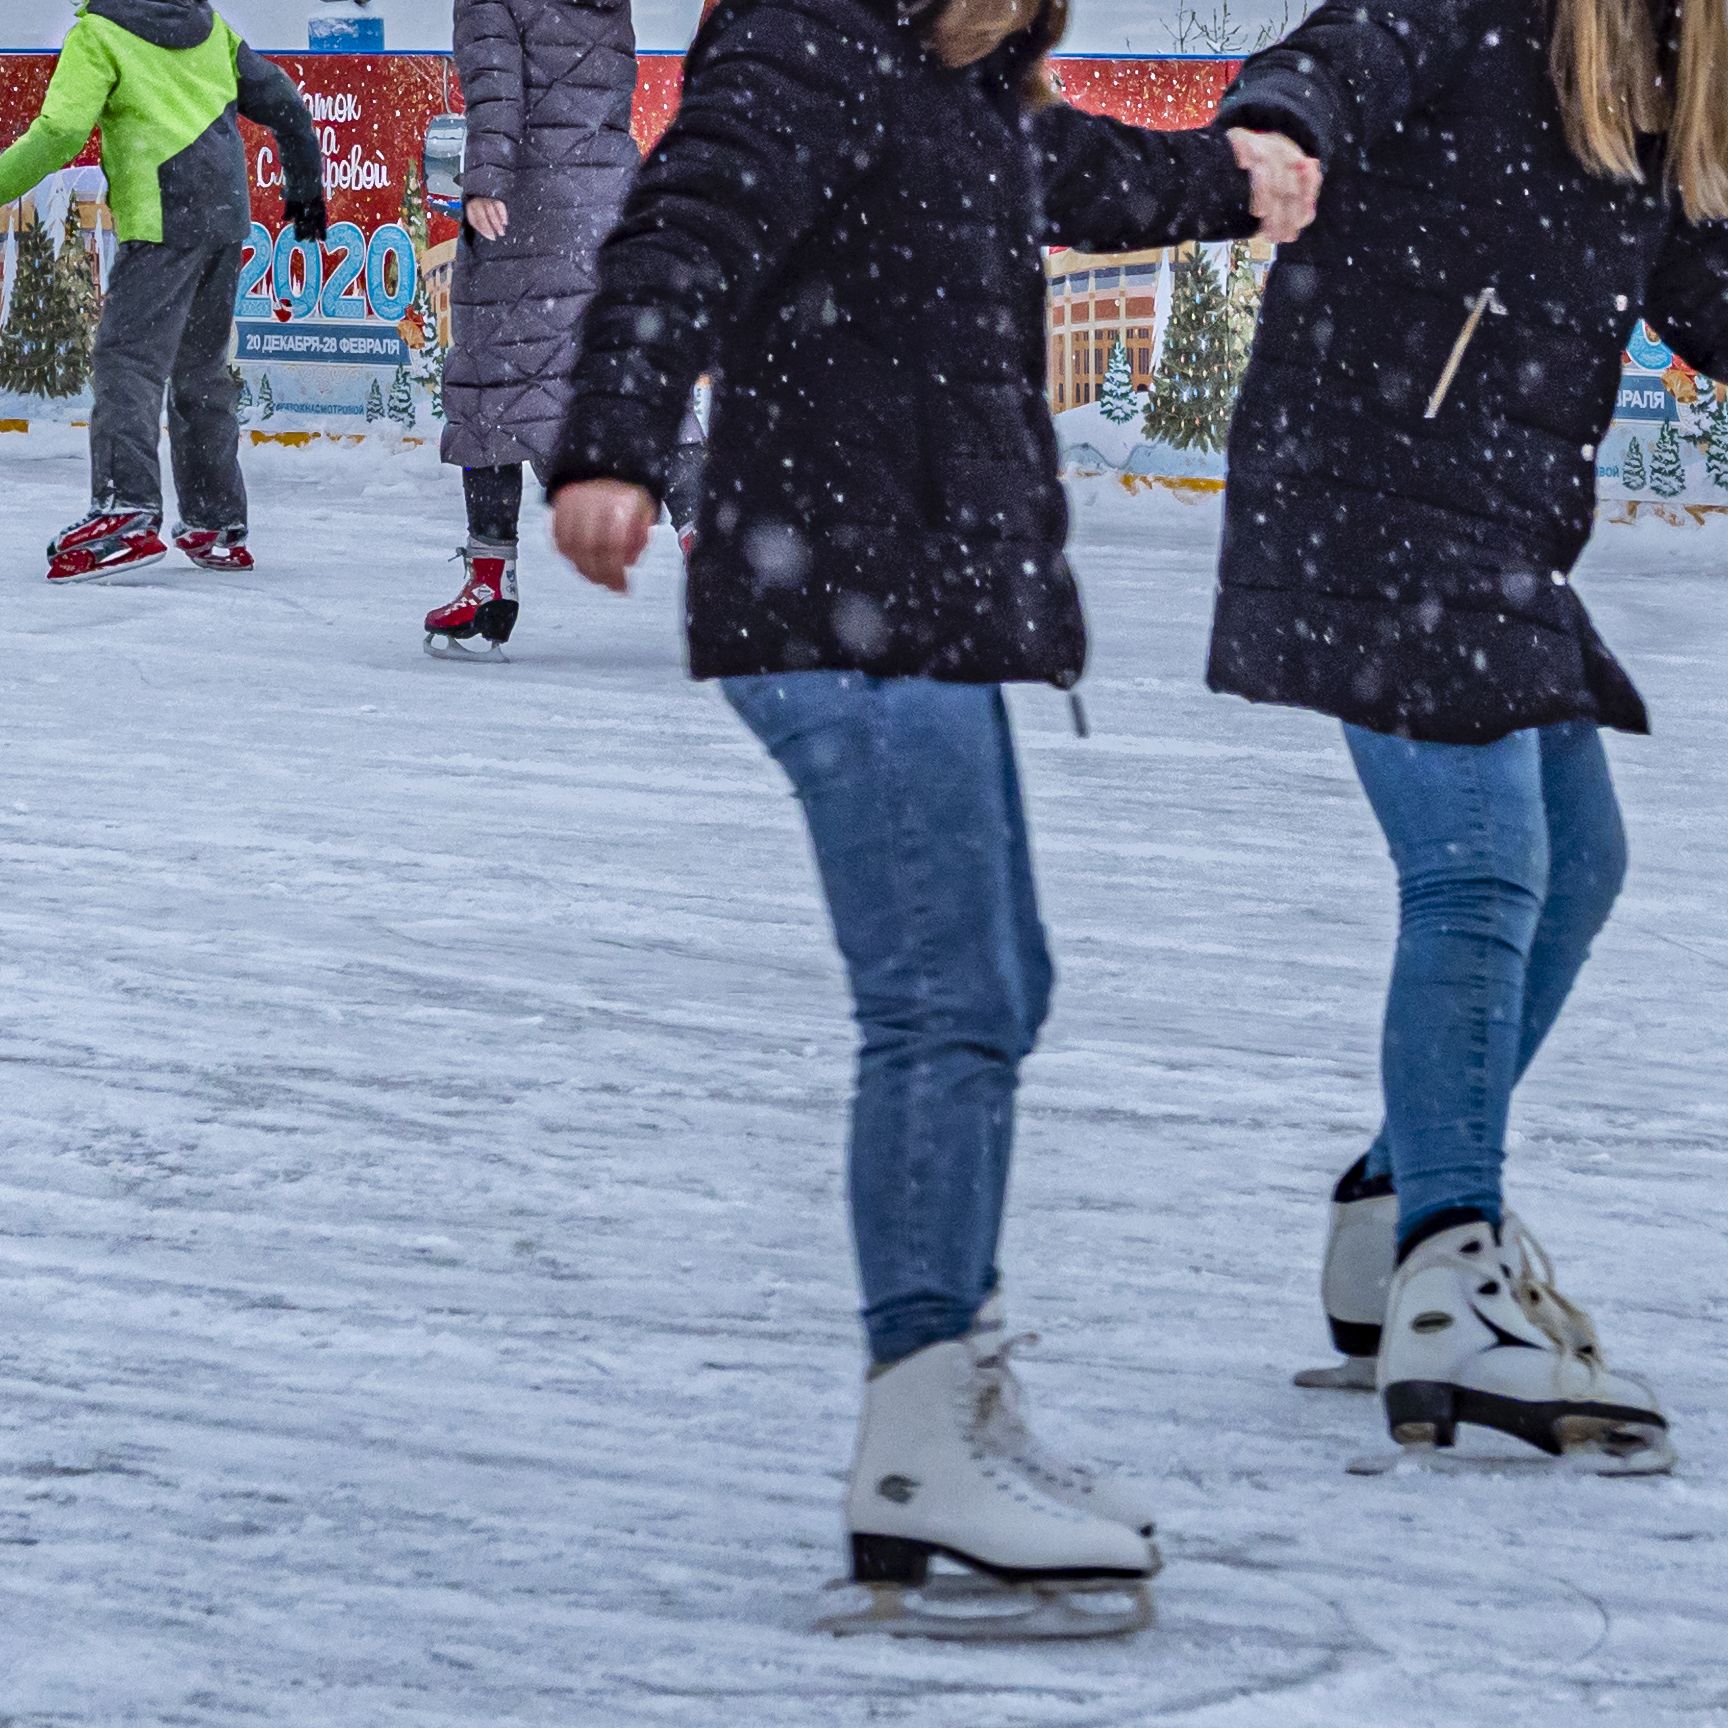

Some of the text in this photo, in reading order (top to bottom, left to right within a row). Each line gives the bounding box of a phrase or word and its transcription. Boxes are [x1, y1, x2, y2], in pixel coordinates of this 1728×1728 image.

[297, 80, 362, 122] аток
[234, 221, 417, 322] 2020
[246, 334, 261, 351] 20
[339, 337, 401, 355] ФЕВРАЛЯ
